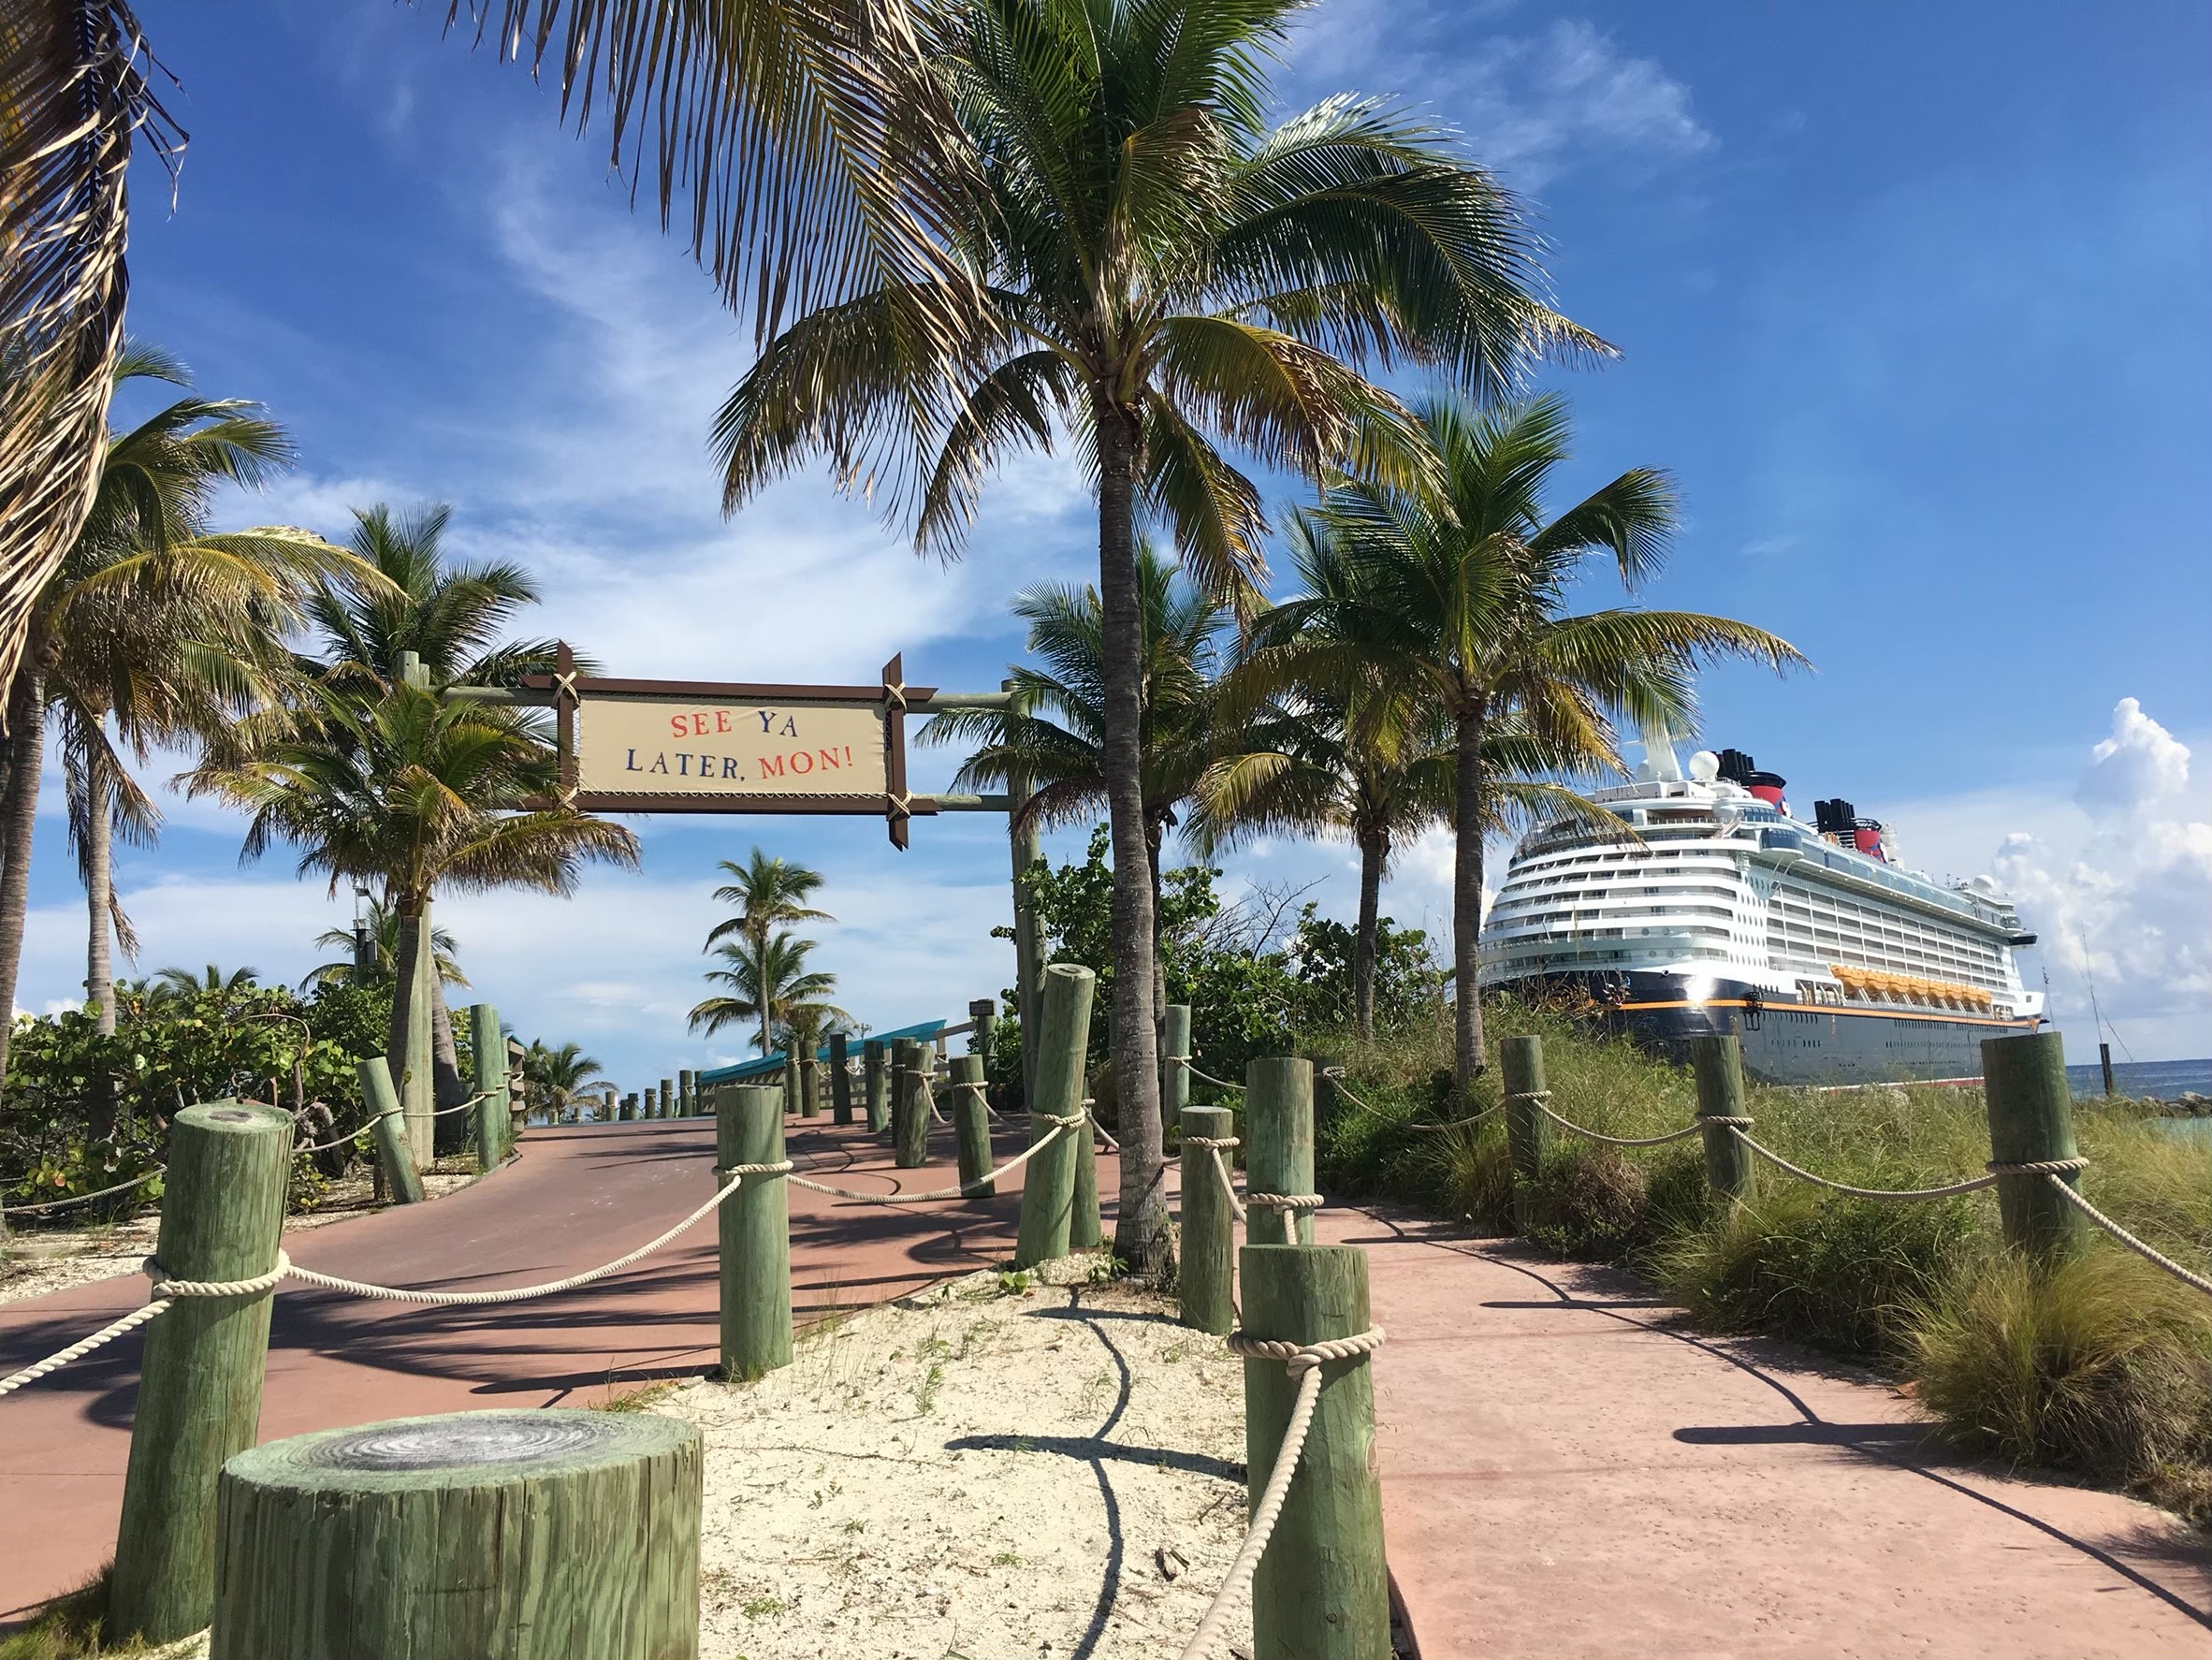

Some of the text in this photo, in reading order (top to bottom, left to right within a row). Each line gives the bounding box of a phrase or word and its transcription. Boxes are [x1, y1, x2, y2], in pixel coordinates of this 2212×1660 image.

[670, 710, 799, 738] SEE YA
[625, 746, 853, 782] LATER, MON!
